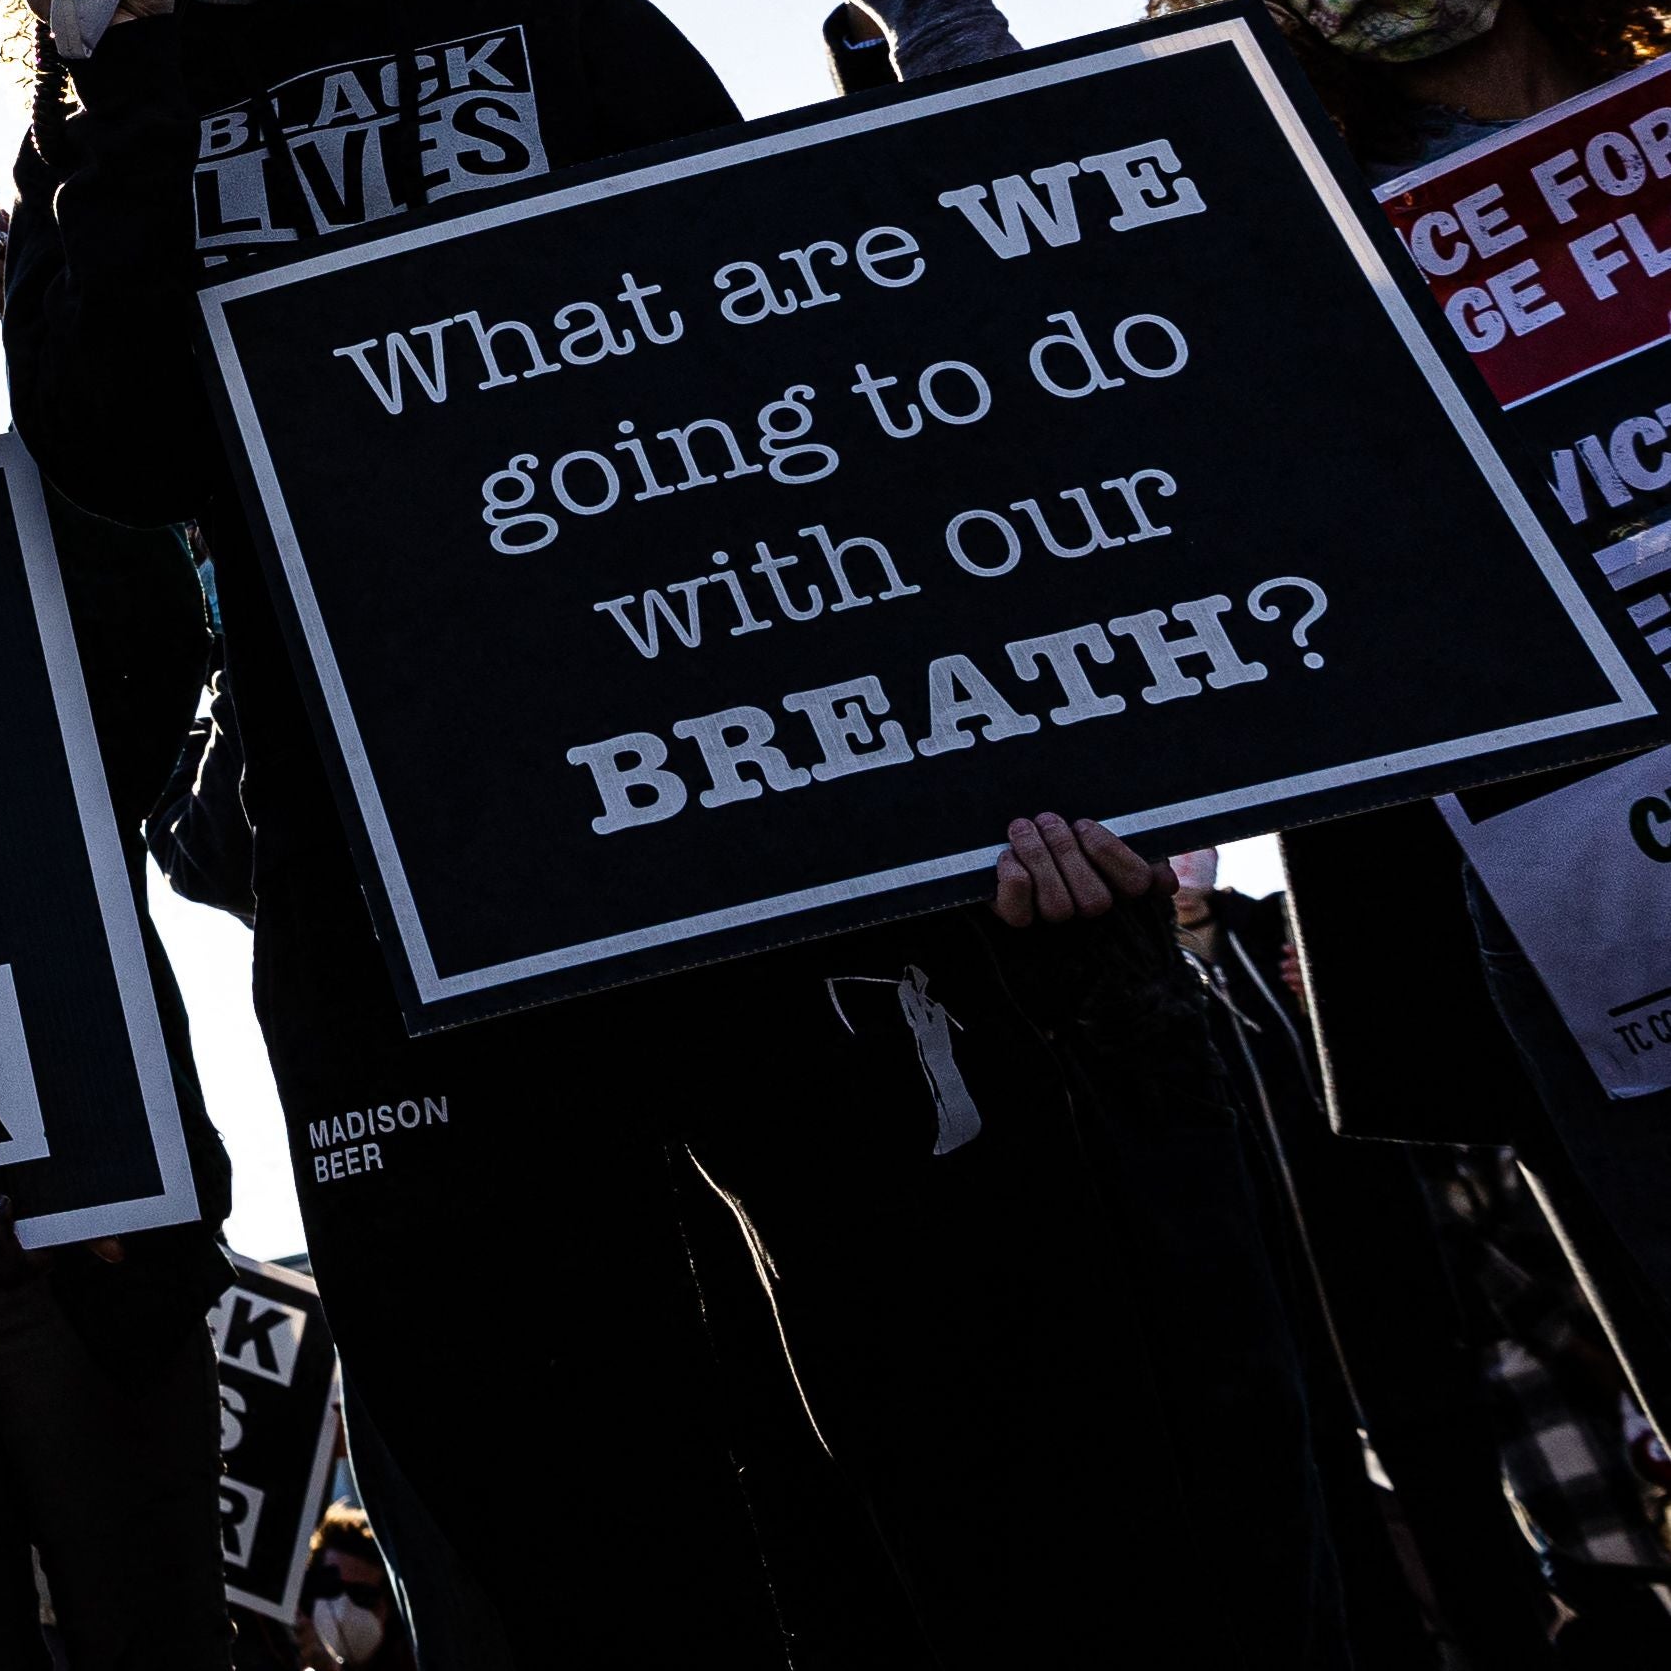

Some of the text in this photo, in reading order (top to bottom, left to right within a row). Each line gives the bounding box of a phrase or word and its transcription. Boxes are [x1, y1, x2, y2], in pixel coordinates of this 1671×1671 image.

[194, 96, 531, 240] LIVES
[334, 138, 1208, 416] What are WE
[1568, 213, 1671, 301] FL
[481, 311, 1191, 554] going to do
[1548, 403, 1671, 525] VIC
[593, 467, 1178, 659] with our
[566, 575, 1330, 836] BREATH?
[308, 1096, 449, 1150] MADISON
[314, 1142, 384, 1183] BEER
